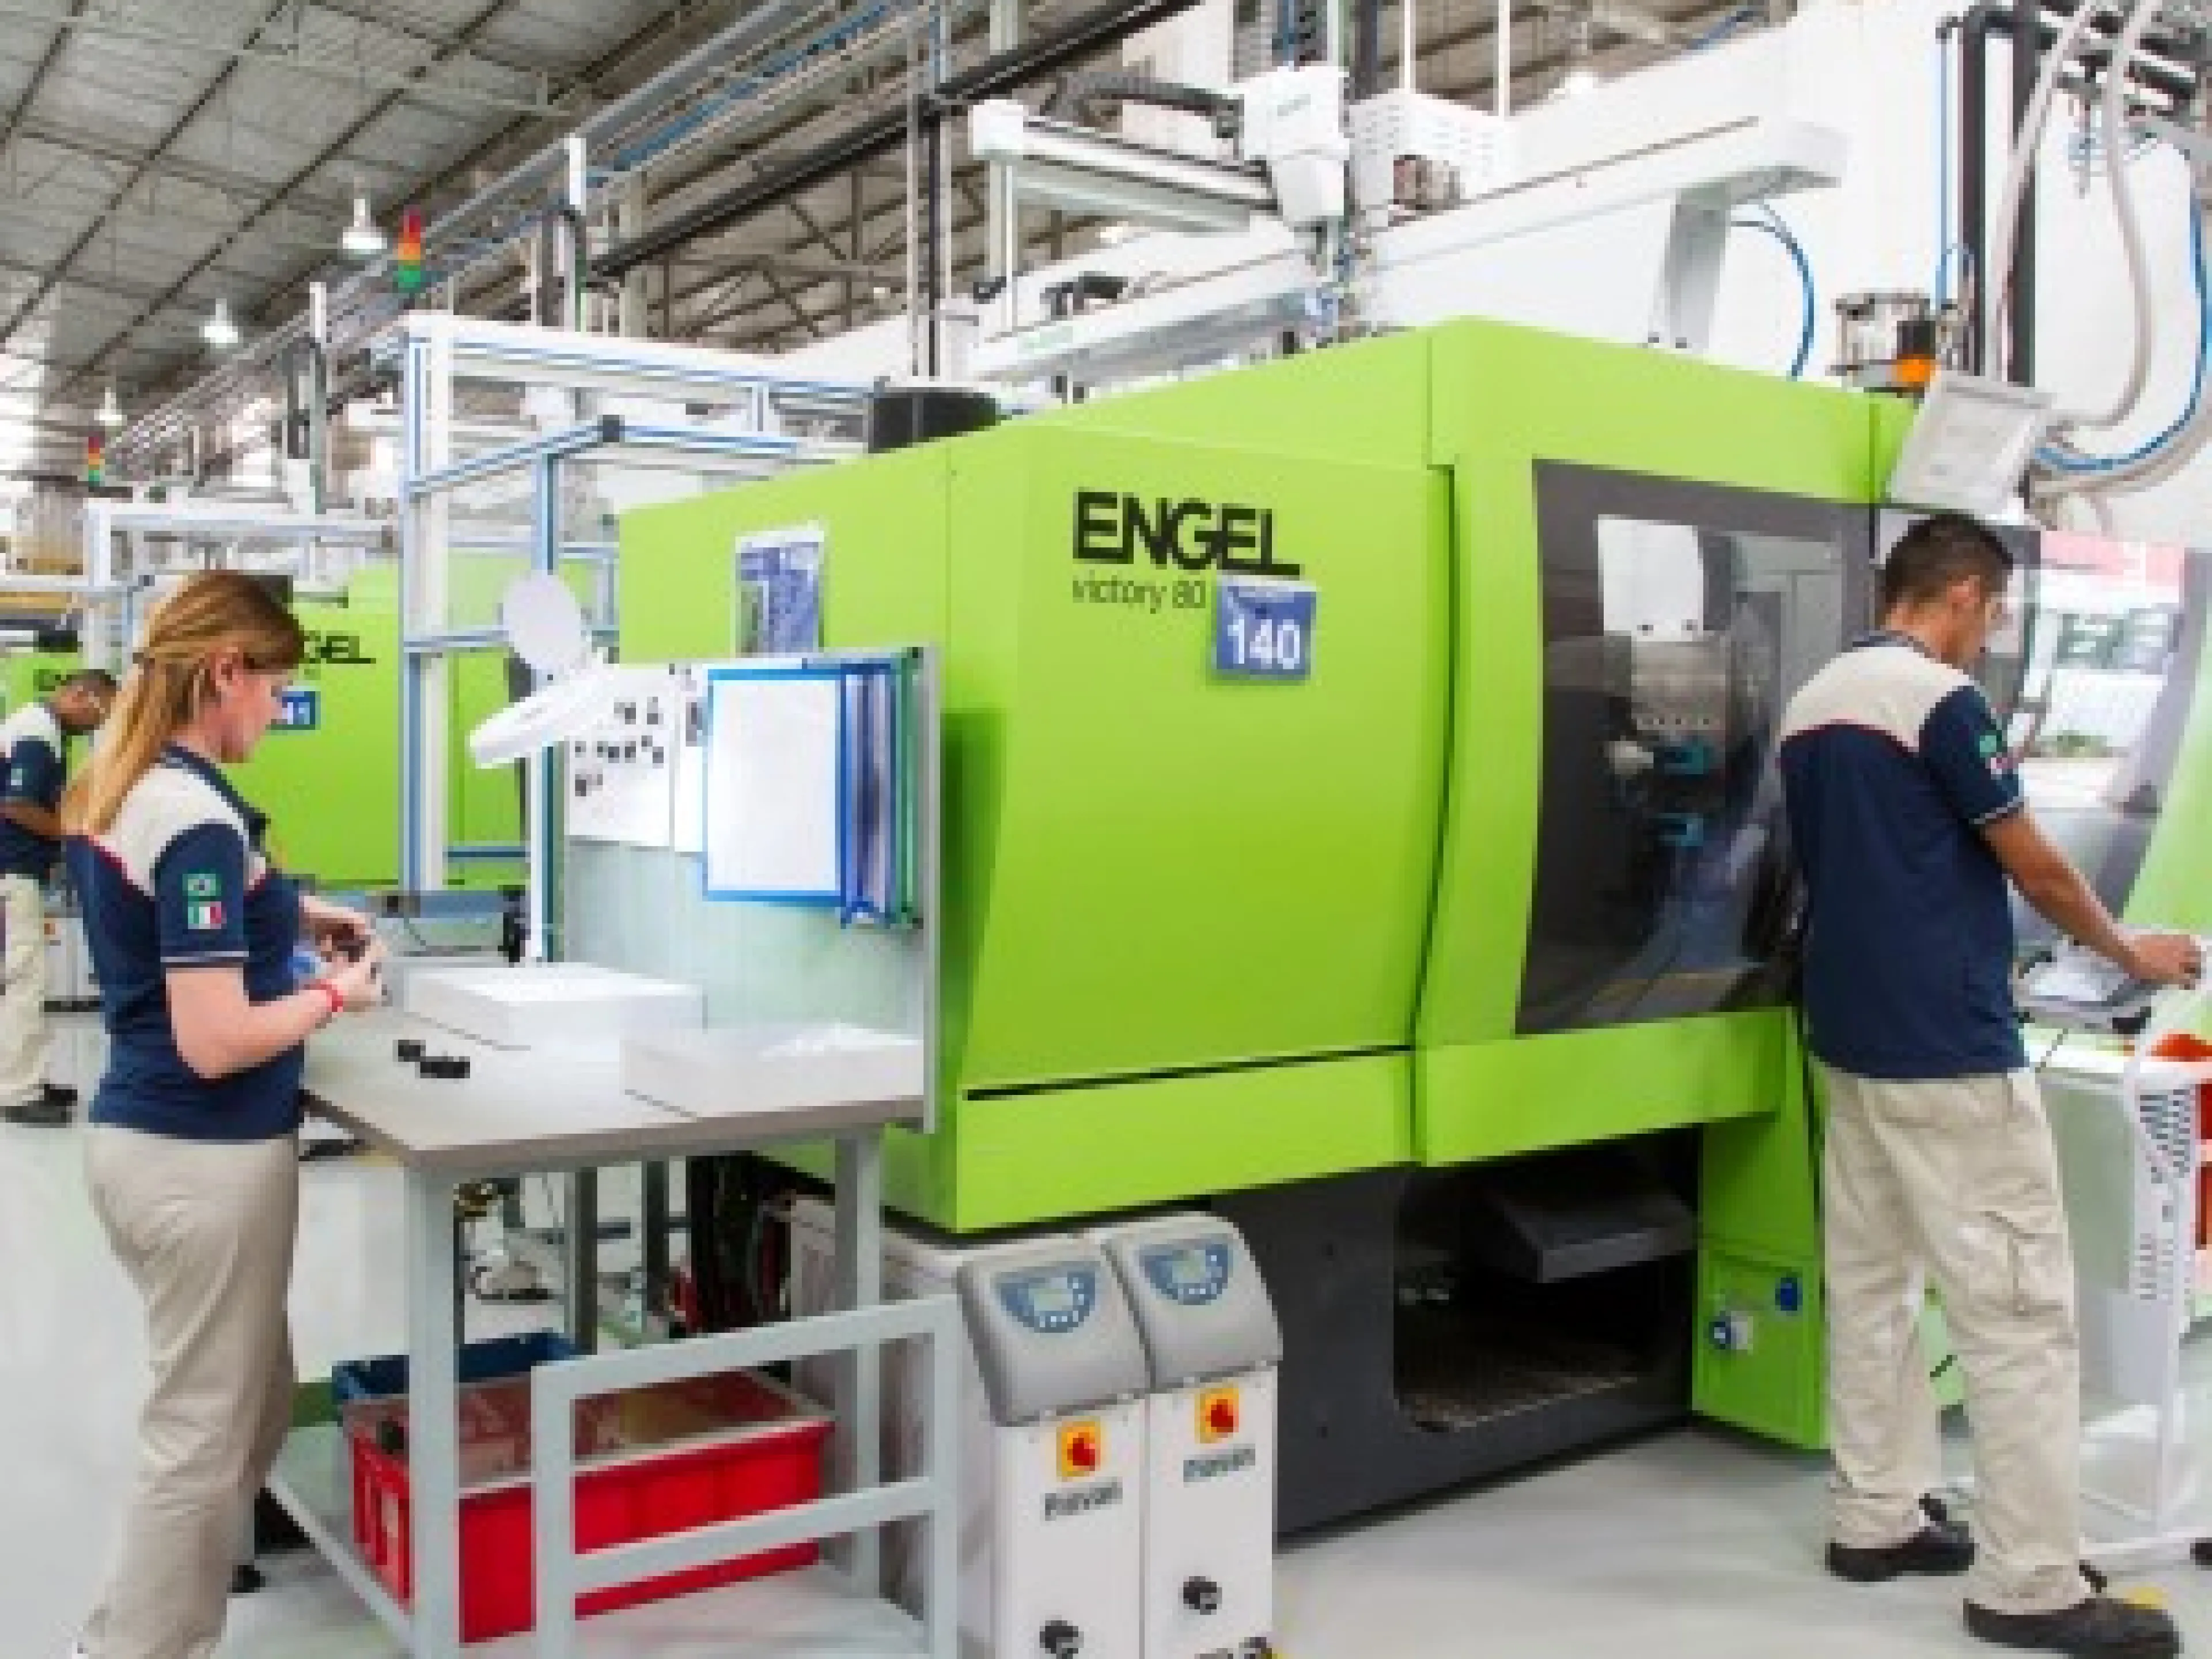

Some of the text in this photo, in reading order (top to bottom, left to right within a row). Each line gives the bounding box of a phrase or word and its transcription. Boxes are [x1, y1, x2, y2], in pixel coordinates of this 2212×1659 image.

[1074, 490, 1301, 579] ENGEL
[1172, 579, 1206, 609] 80
[1227, 613, 1301, 669] 140
